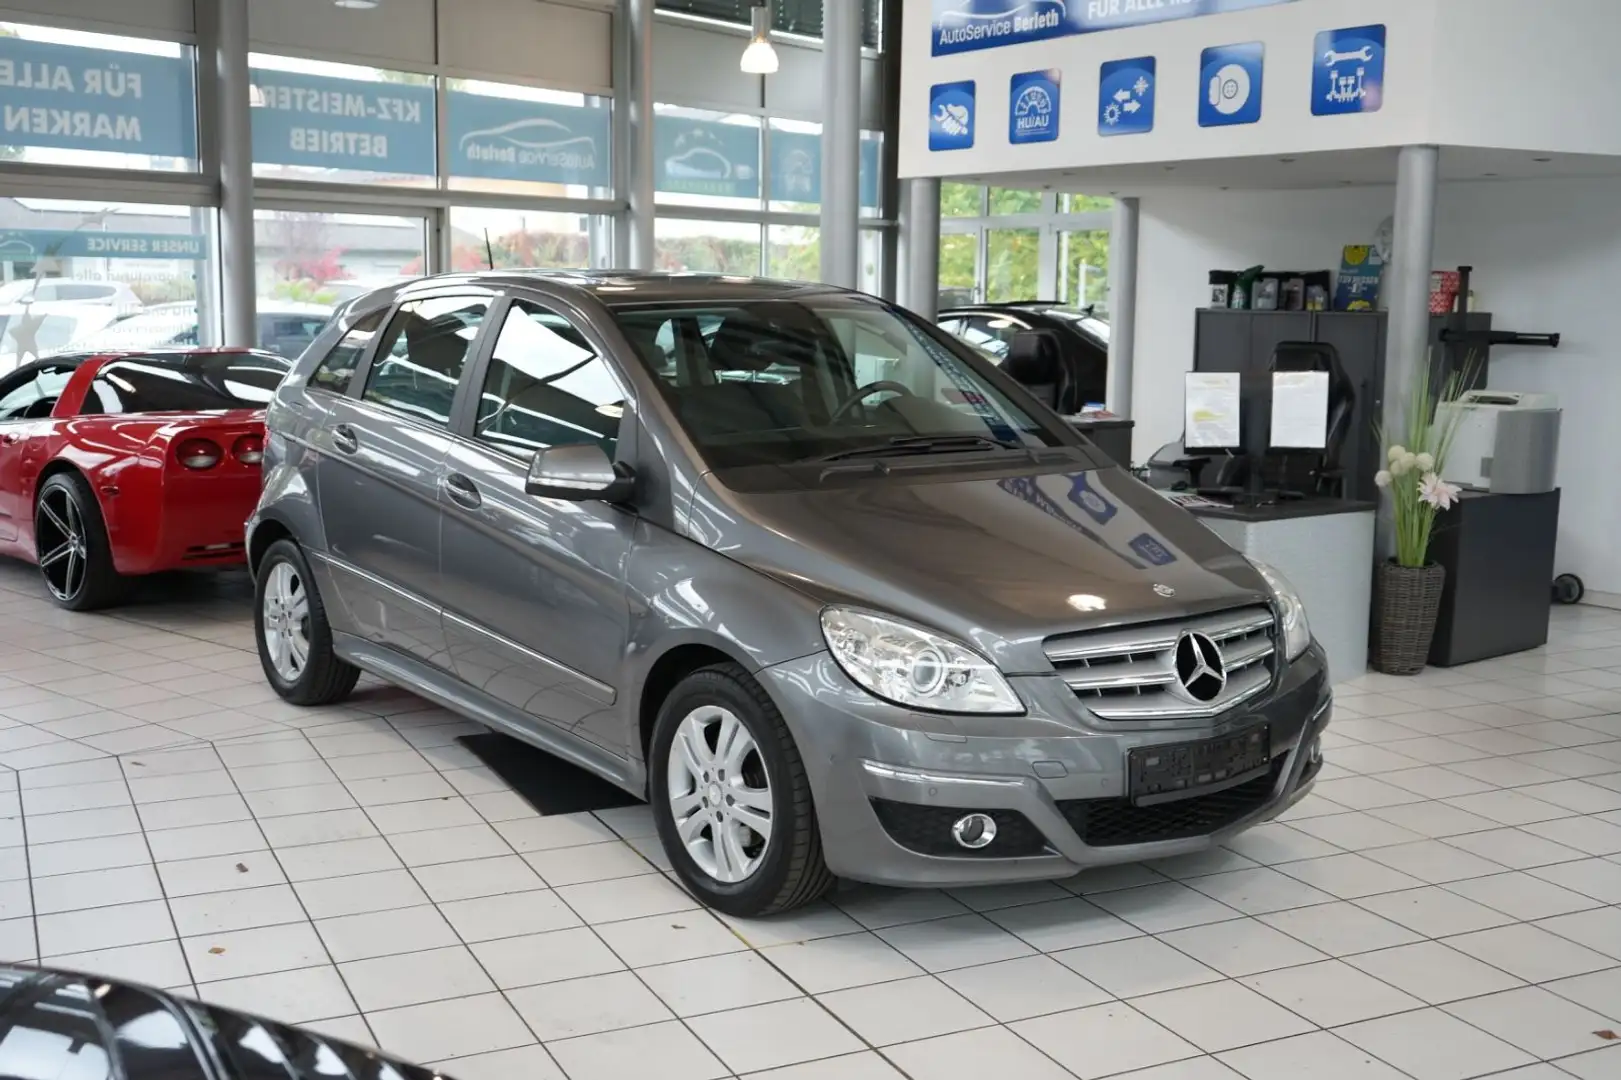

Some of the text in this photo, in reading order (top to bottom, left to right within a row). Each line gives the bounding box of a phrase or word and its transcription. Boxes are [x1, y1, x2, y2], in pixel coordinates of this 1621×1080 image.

[939, 8, 1059, 46] AutoService Berleth
[1017, 114, 1049, 129] HU/AU
